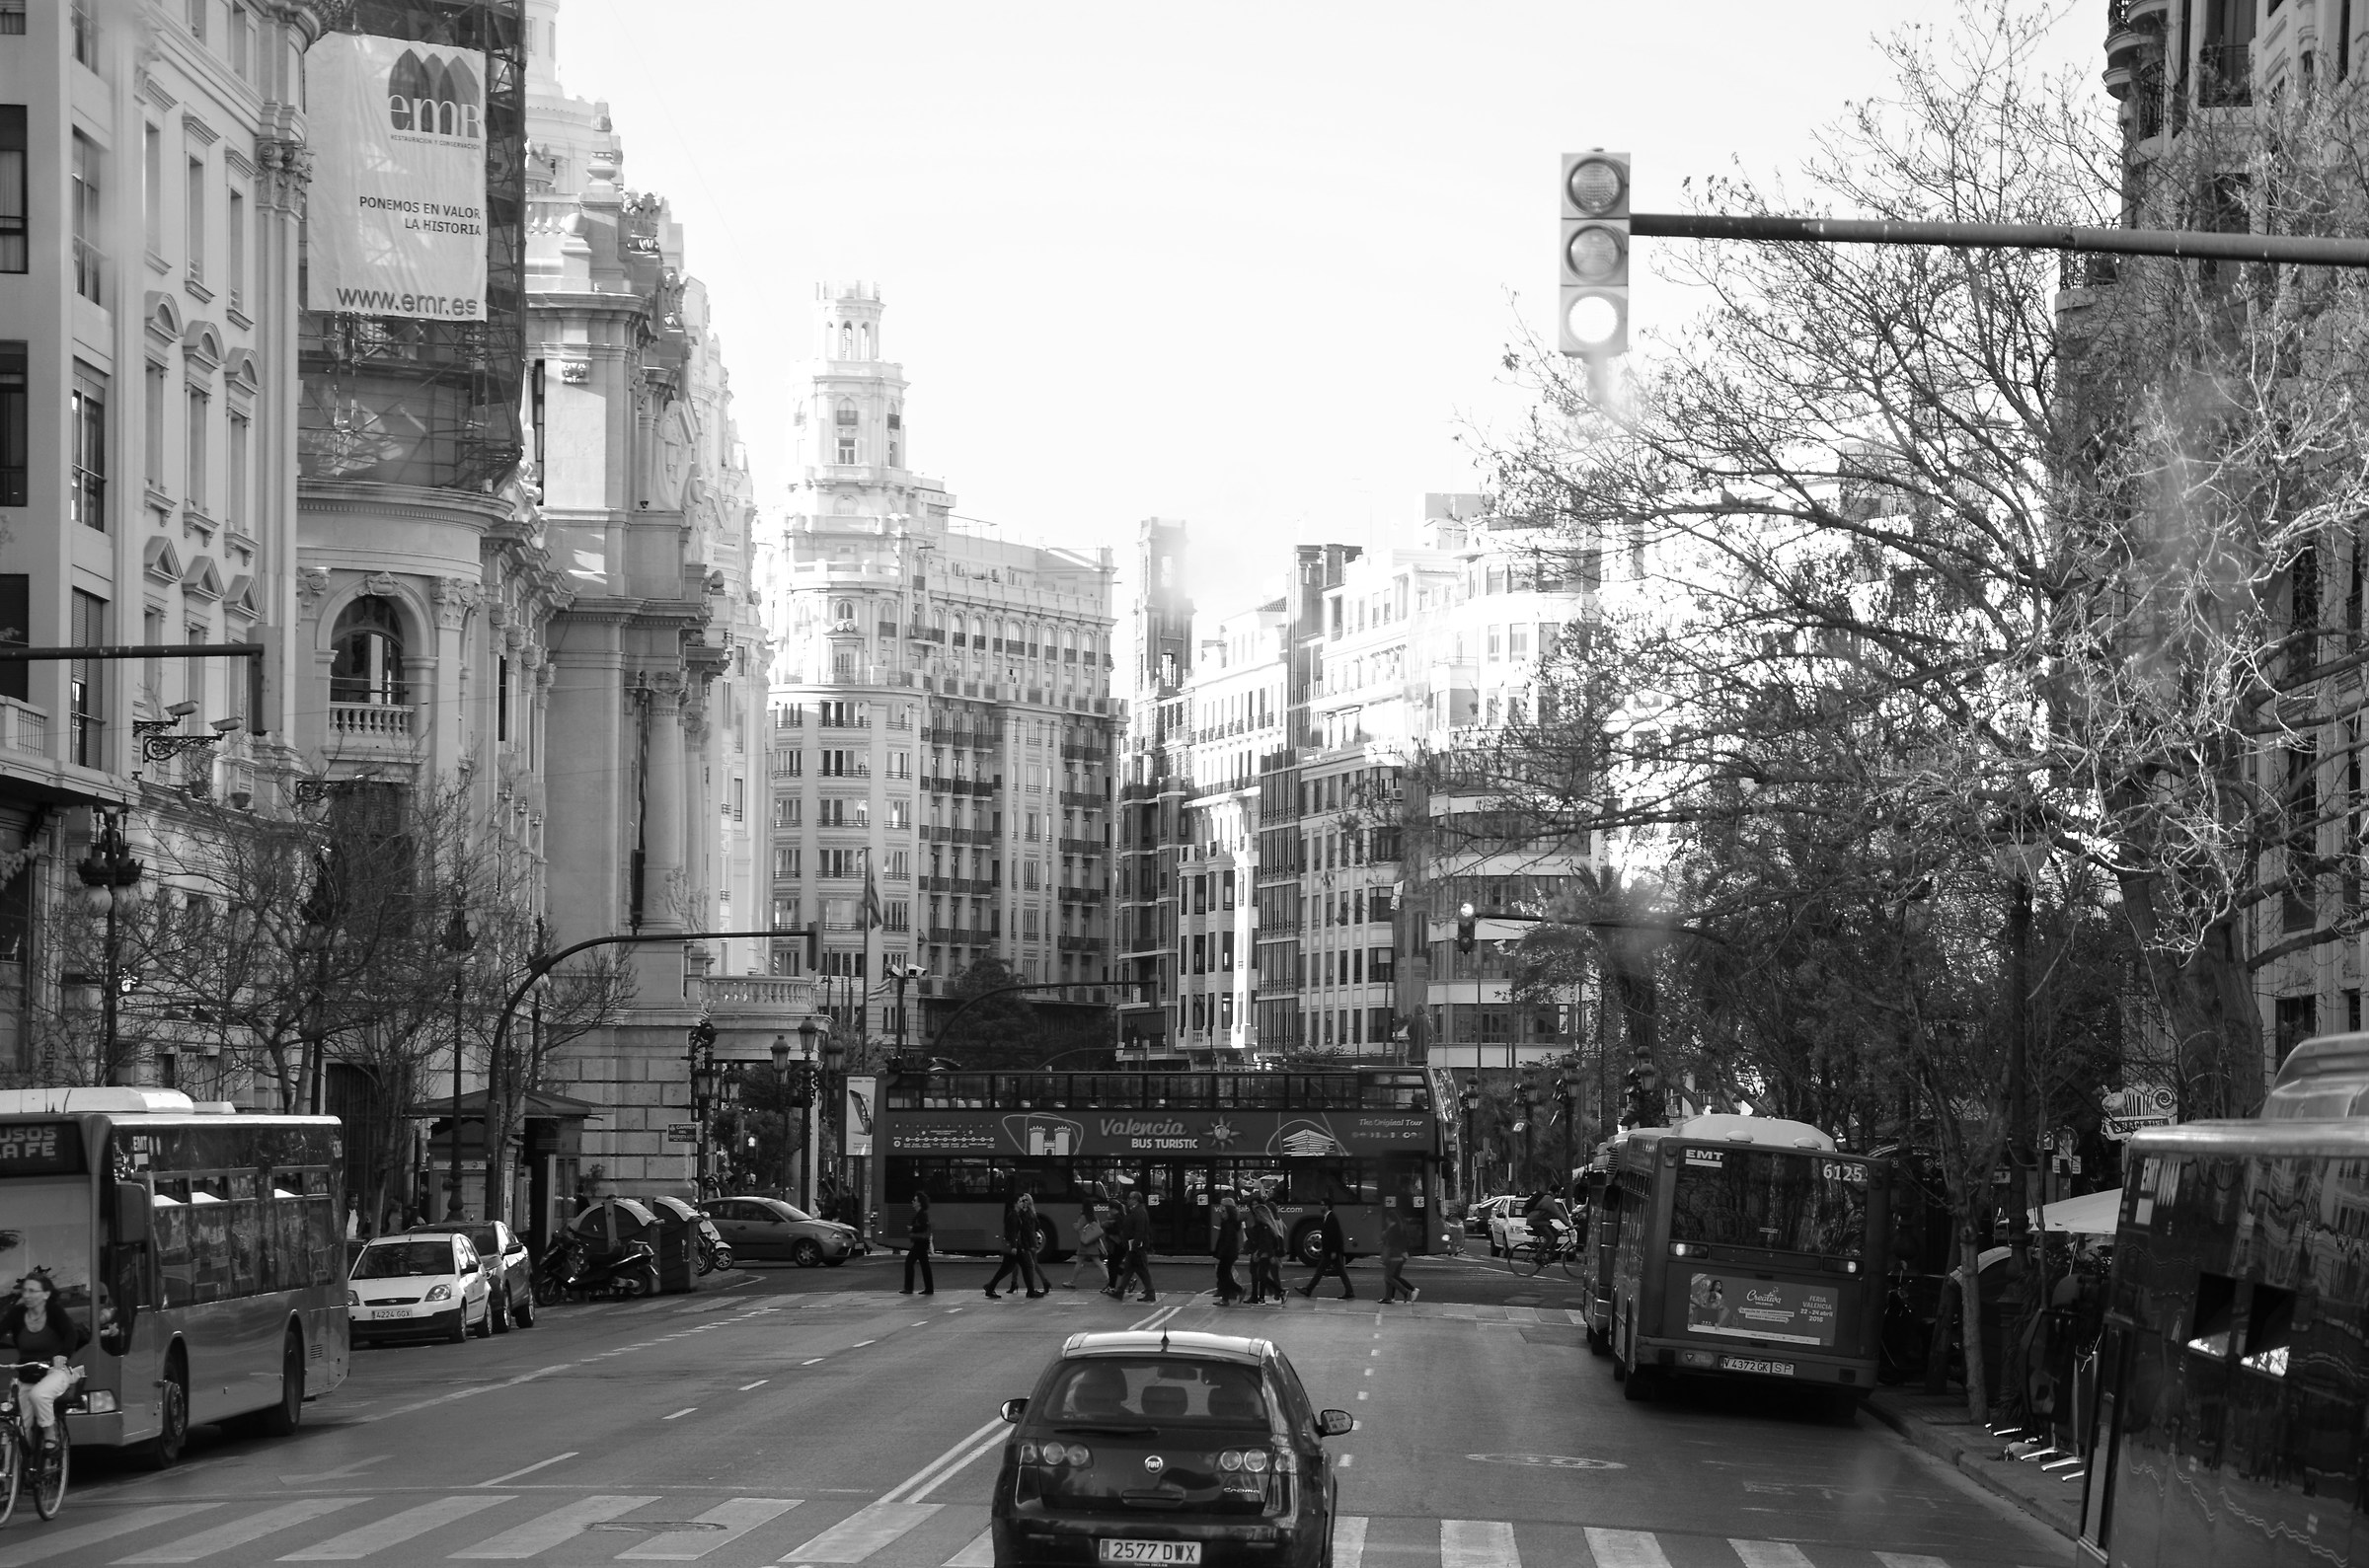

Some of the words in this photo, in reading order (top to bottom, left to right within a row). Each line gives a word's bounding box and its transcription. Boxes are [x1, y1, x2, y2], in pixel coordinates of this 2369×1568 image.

[359, 196, 420, 213] PONEMOS
[423, 203, 439, 215] EN
[443, 204, 481, 220] VALOR
[405, 218, 420, 230] LA
[423, 219, 481, 236] HISTORIA
[337, 287, 478, 316] www.emr.es
[1100, 1117, 1187, 1137] Valencia
[1374, 1118, 1404, 1128] Original
[25, 1141, 56, 1157] FE
[1131, 1138, 1153, 1149] BUS
[1154, 1138, 1198, 1150] TURISTIC
[1685, 1149, 1723, 1160] EMT
[1823, 1163, 1863, 1182] 6125
[1746, 1289, 1782, 1305] Creativa
[1113, 1542, 1158, 1559] 2577
[1163, 1544, 1195, 1562] DWX
